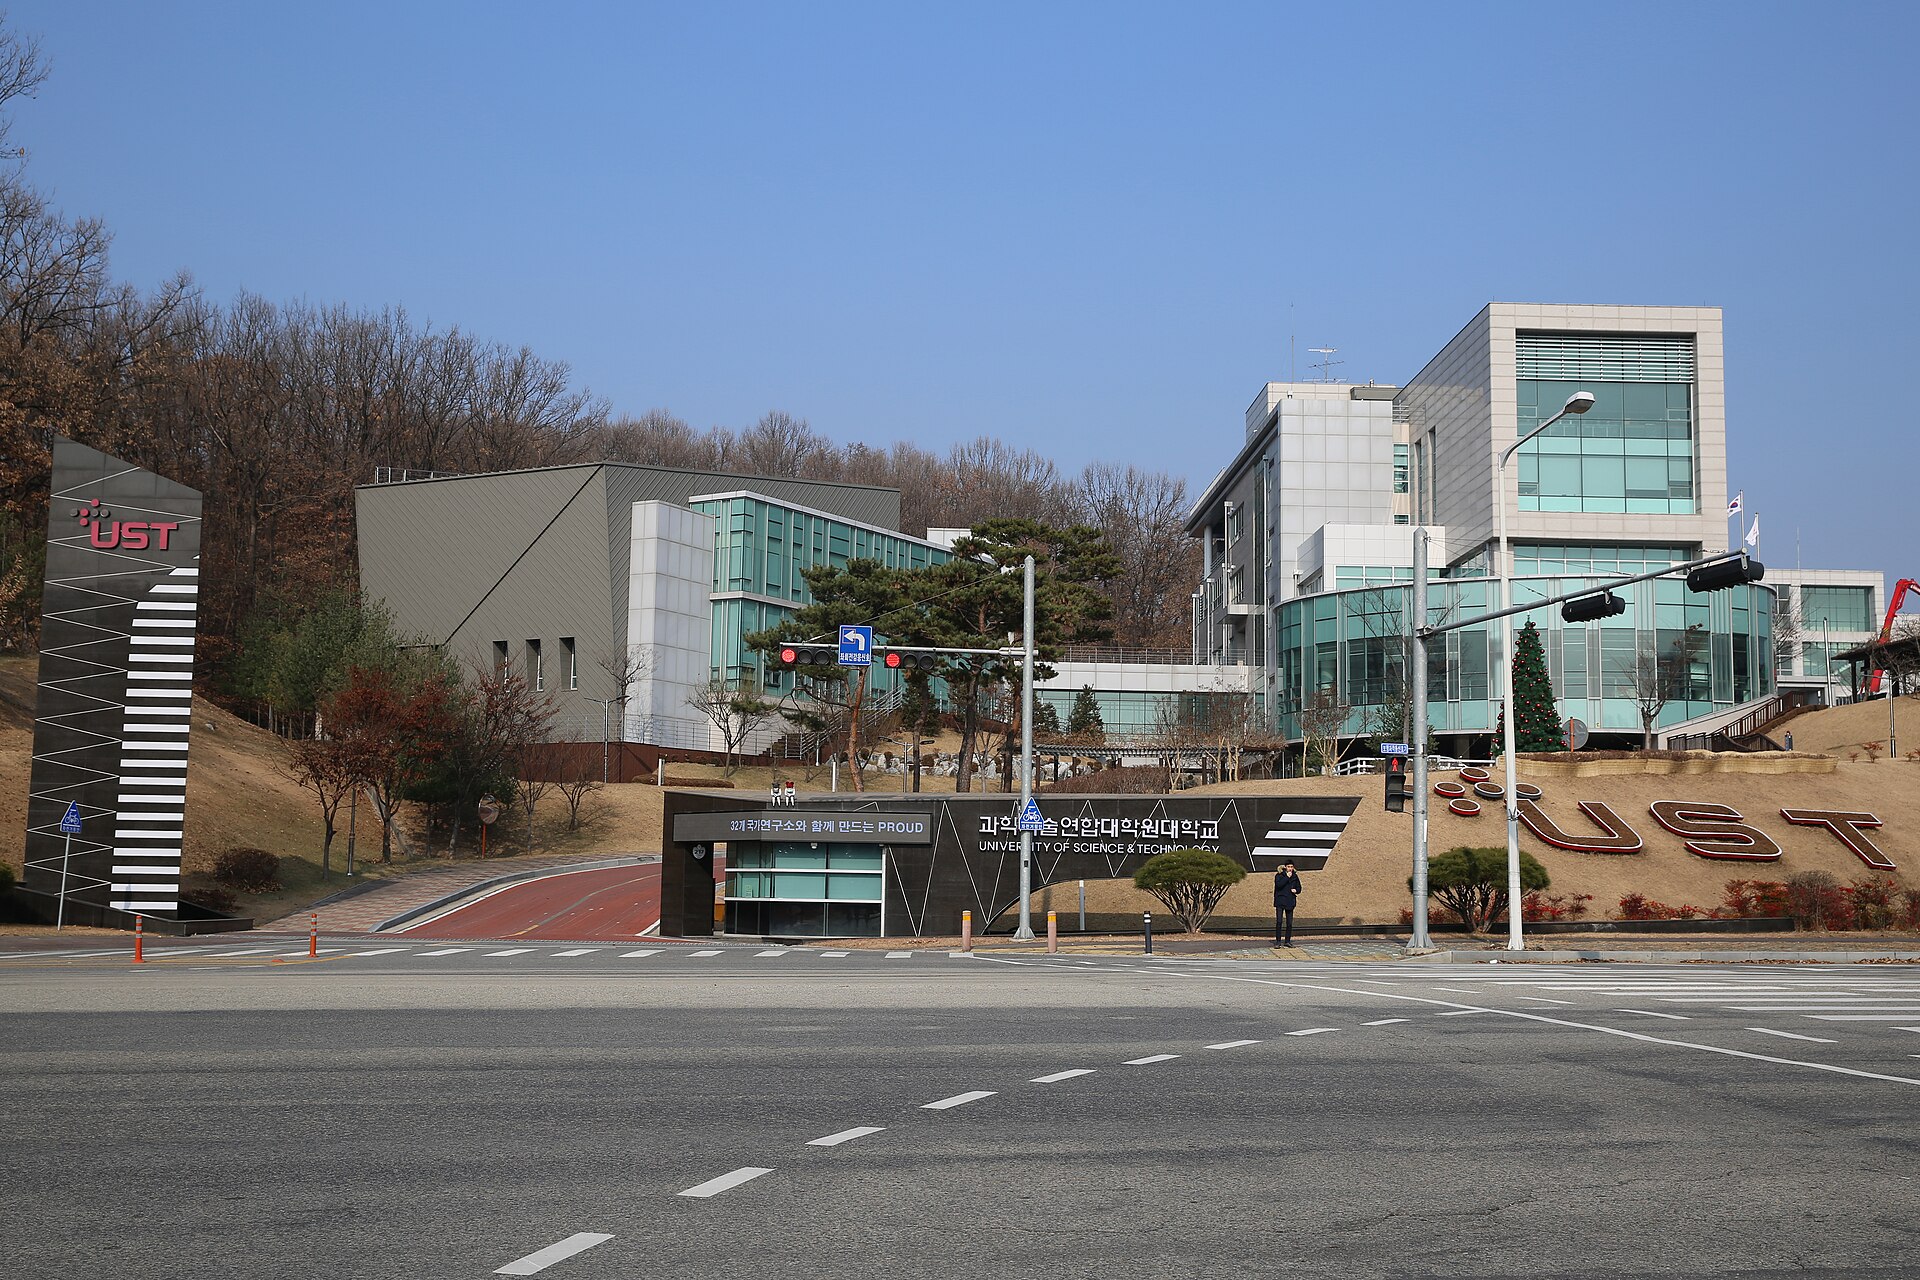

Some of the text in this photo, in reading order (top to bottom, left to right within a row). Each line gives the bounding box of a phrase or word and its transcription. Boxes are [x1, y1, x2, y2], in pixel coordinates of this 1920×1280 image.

[91, 521, 178, 550] UST
[730, 820, 746, 831] 32개
[811, 820, 835, 833] 함께
[839, 821, 874, 833] 만드는
[878, 822, 924, 833] PROUD
[979, 815, 1219, 840] 과학술연합대학원대학교
[1505, 798, 1897, 870] UST
[979, 841, 1052, 853] UNIVERITY
[1053, 842, 1070, 853] OF
[1073, 842, 1125, 854] SCIENCE
[1127, 843, 1135, 854] &
